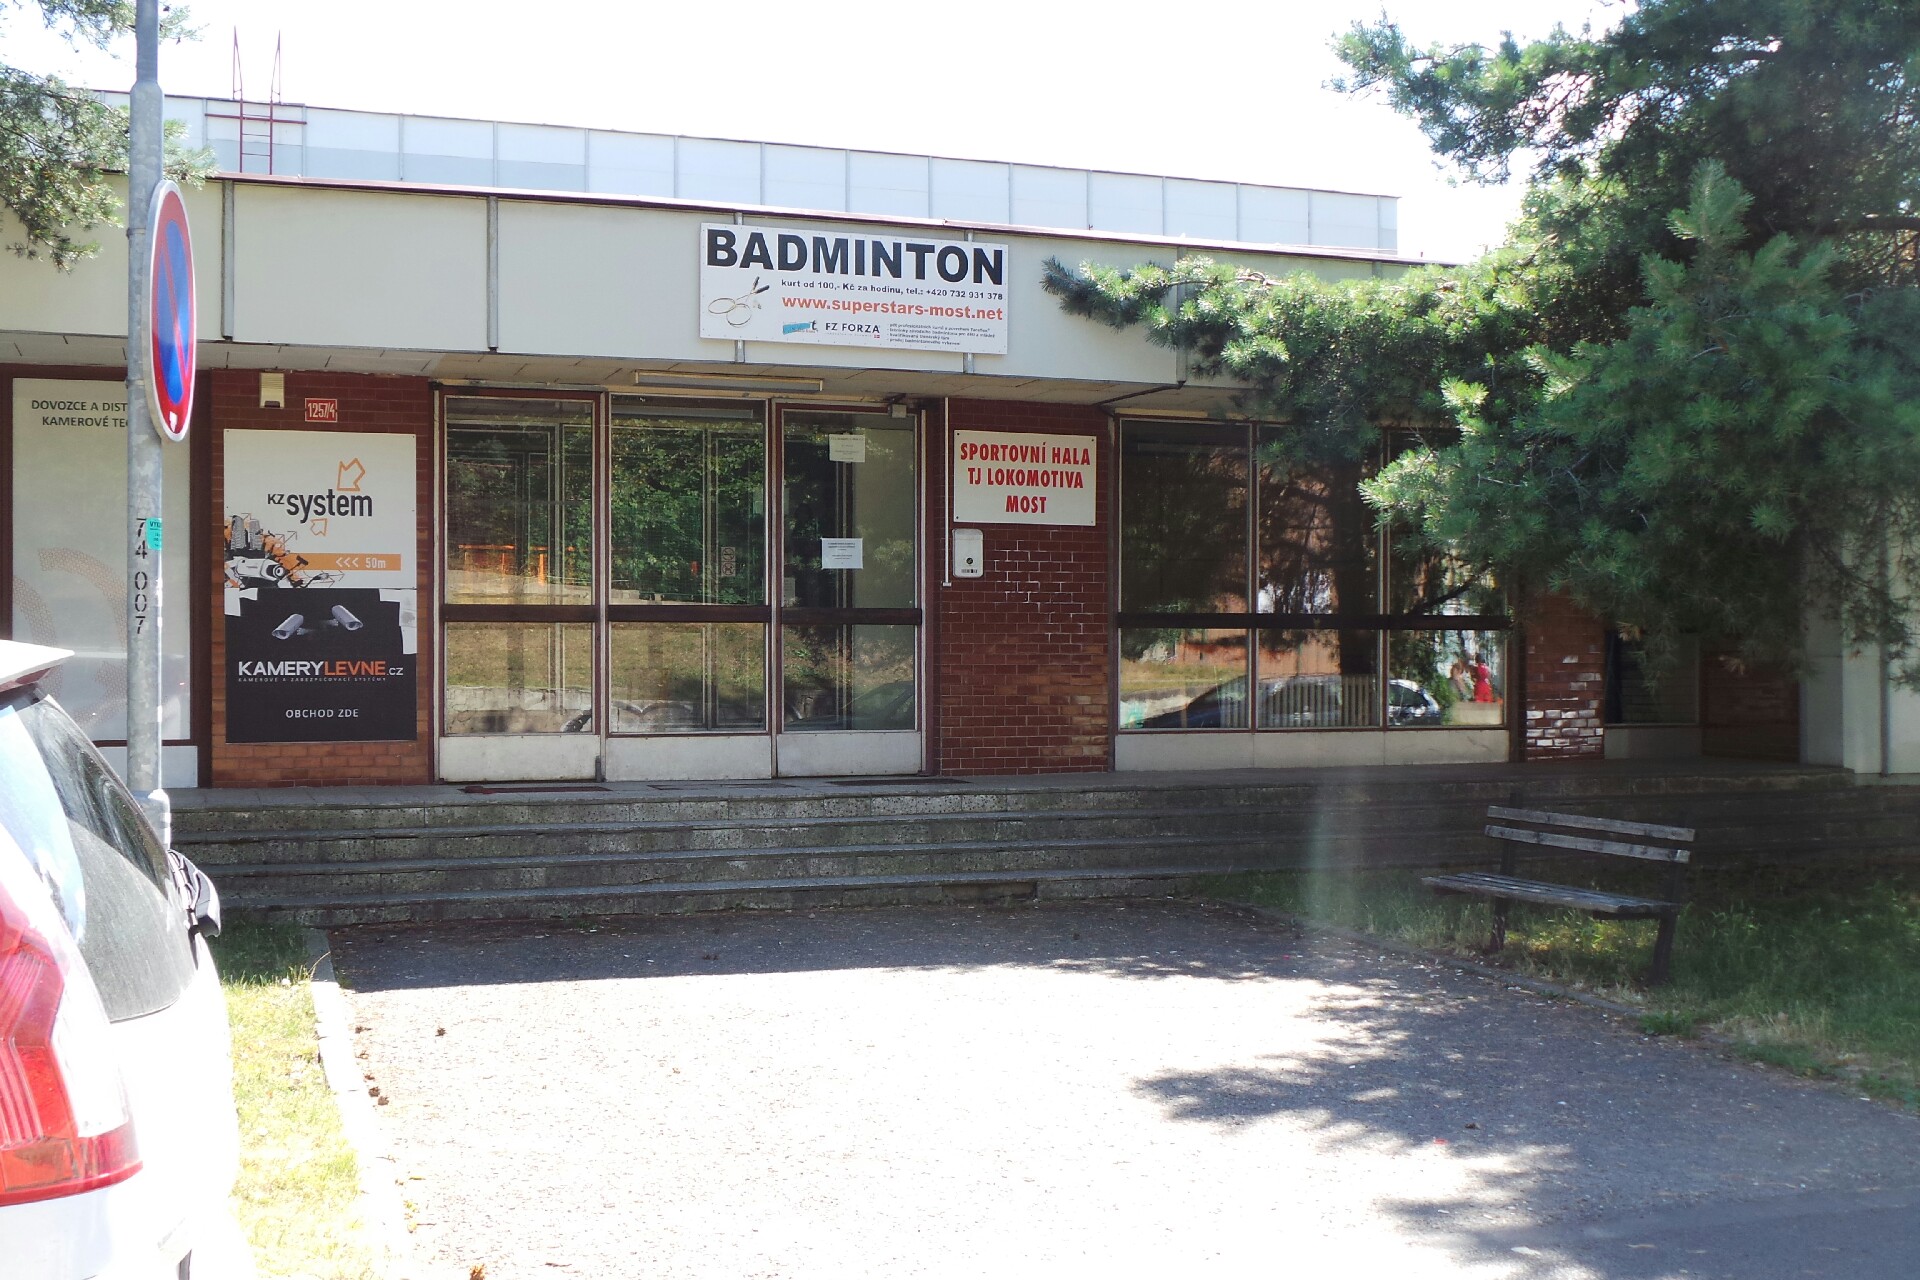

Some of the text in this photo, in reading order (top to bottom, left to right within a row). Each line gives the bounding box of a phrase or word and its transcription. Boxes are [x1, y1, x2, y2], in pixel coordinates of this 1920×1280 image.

[706, 228, 1003, 286] BADMINTON
[781, 279, 801, 288] kurt
[803, 280, 815, 289] od
[817, 281, 840, 291] 100,-
[842, 283, 855, 291] Kč
[870, 284, 904, 295] hodinu,
[906, 287, 924, 296] tel.:
[926, 288, 948, 297] +420
[950, 289, 967, 298] 732
[968, 291, 984, 299] 931
[987, 292, 1003, 300] 378
[782, 296, 1003, 321] www.superstars-most.net
[825, 322, 838, 331] FZ
[841, 323, 880, 334] FORZA
[31, 400, 87, 411] DOVOZCE
[90, 401, 99, 411] A
[307, 402, 335, 419] 1257/4
[42, 415, 109, 428] KAMEROVÉ
[960, 441, 1091, 466] SPORTOVNÍ HALA
[967, 467, 1084, 489] TJ LOKOMOTIVA
[267, 489, 373, 524] KZ system
[1005, 495, 1047, 514] MOST
[365, 557, 386, 569] 50m
[285, 708, 359, 719] OBCHOD ZDE
